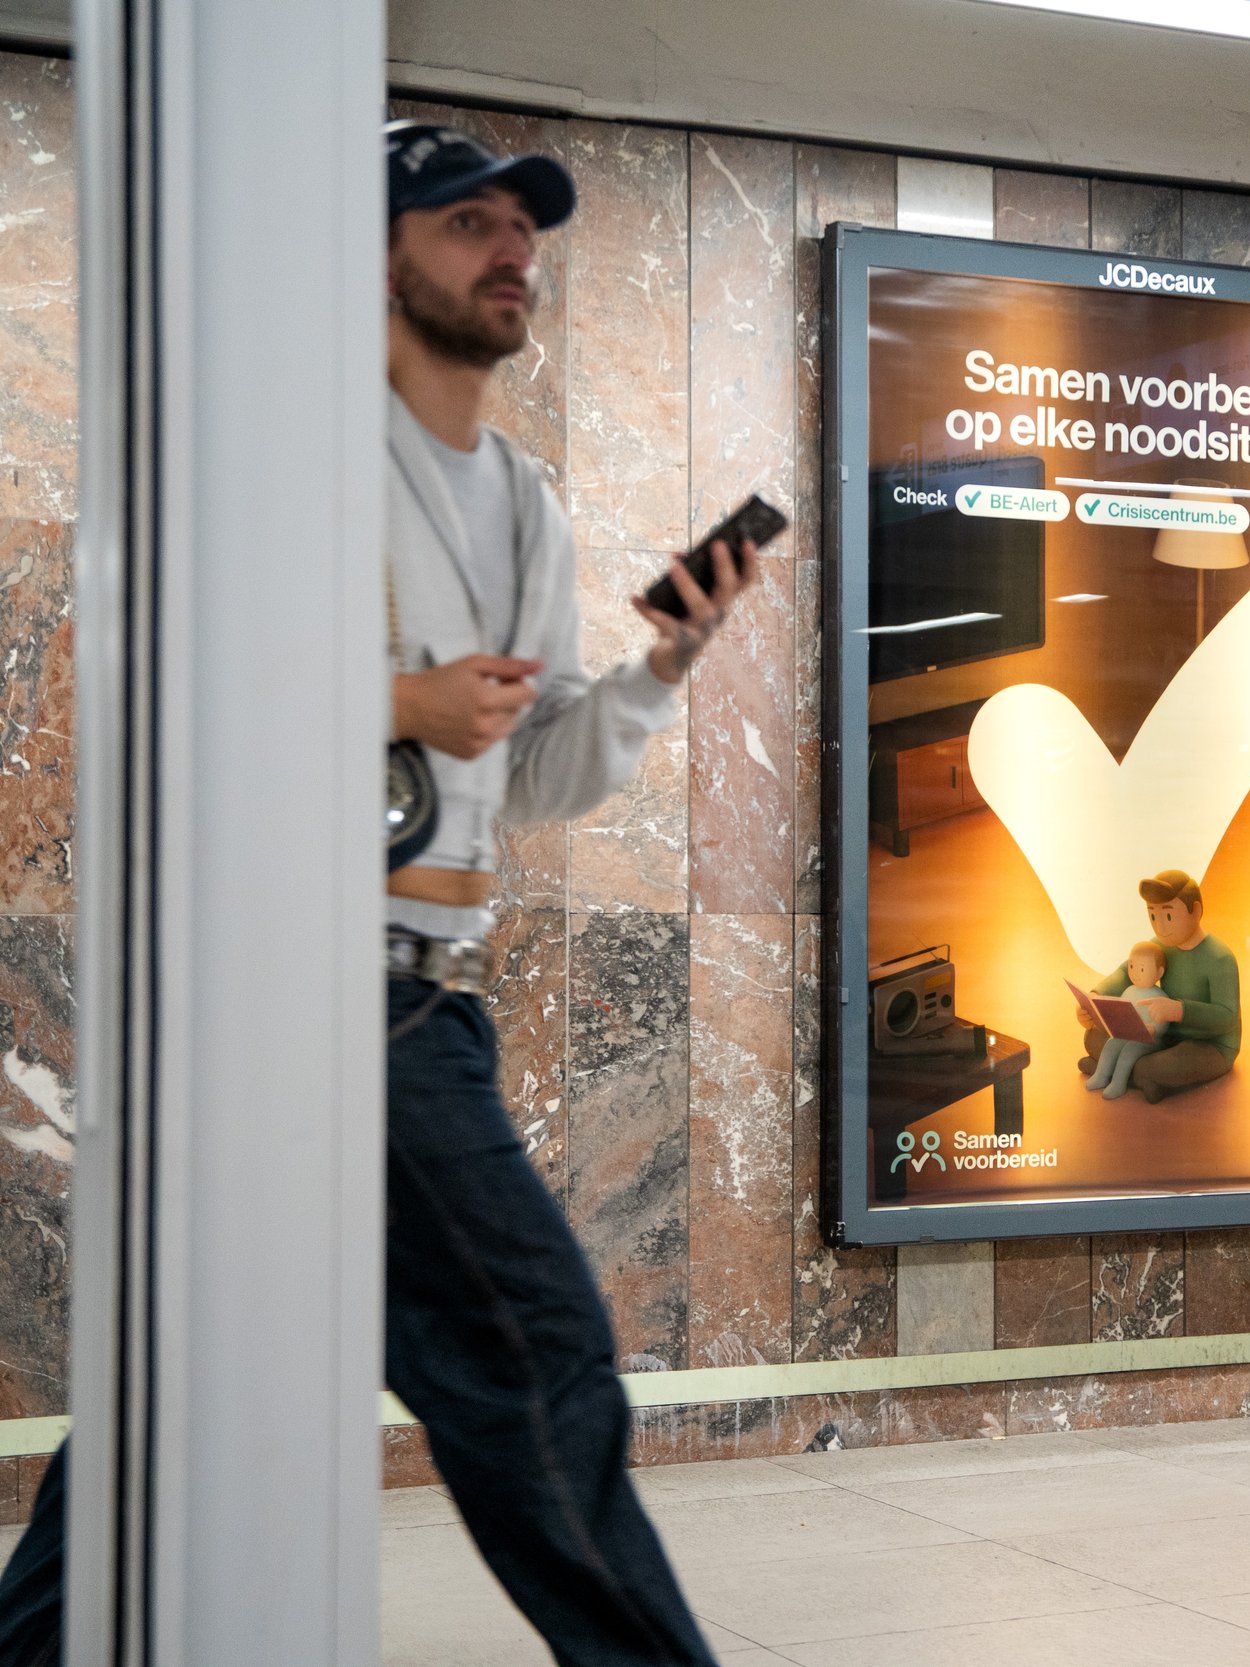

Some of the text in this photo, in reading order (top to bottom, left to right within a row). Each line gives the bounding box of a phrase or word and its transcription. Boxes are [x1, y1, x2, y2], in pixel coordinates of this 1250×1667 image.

[1099, 262, 1216, 295] JCDecaux
[964, 350, 1111, 404] Samen
[945, 408, 1001, 450] op
[1010, 407, 1096, 450] elke
[893, 486, 948, 507] Check
[990, 494, 1058, 513] BE-Alert
[1107, 502, 1237, 526] Crisiscentrum.be
[953, 1130, 1022, 1150] Samen
[953, 1149, 1057, 1170] voorbereid
